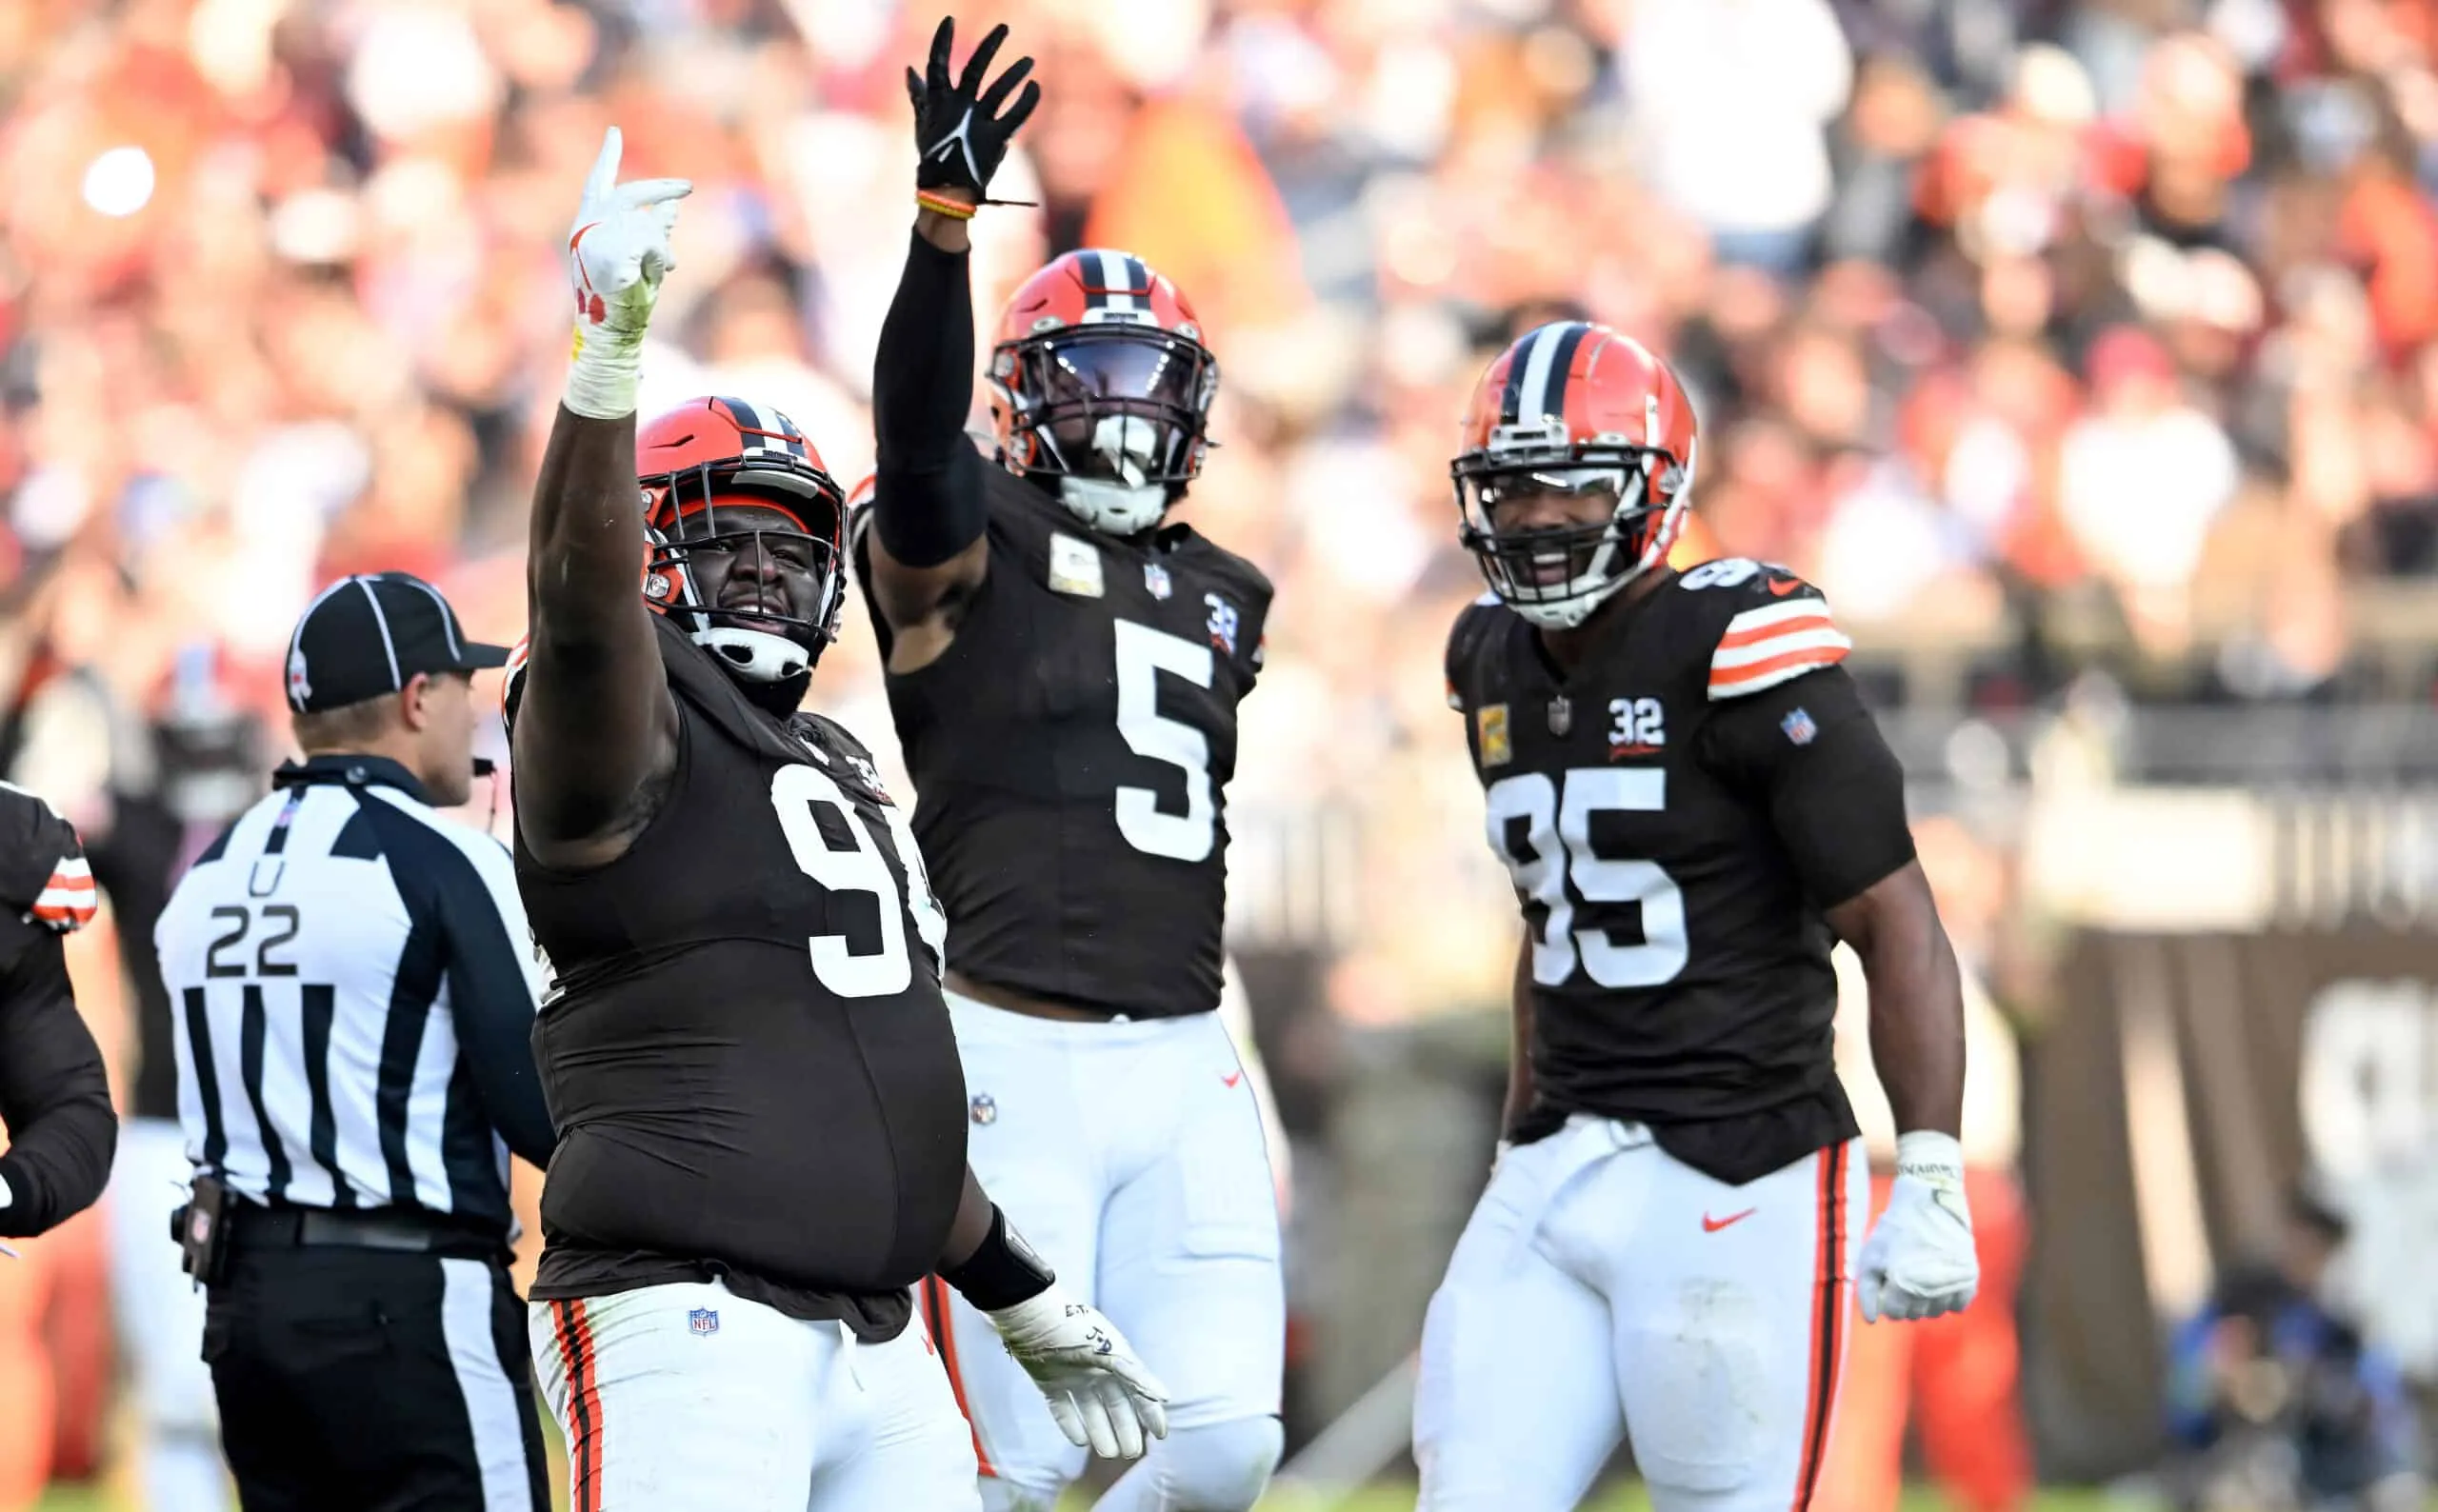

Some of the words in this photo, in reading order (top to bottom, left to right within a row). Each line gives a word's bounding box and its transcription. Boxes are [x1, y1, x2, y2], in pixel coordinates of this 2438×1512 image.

[1114, 618, 1214, 863] 5
[1609, 697, 1666, 746] 32
[249, 861, 285, 898] U
[1486, 767, 1689, 988] 95
[206, 905, 300, 979] 22
